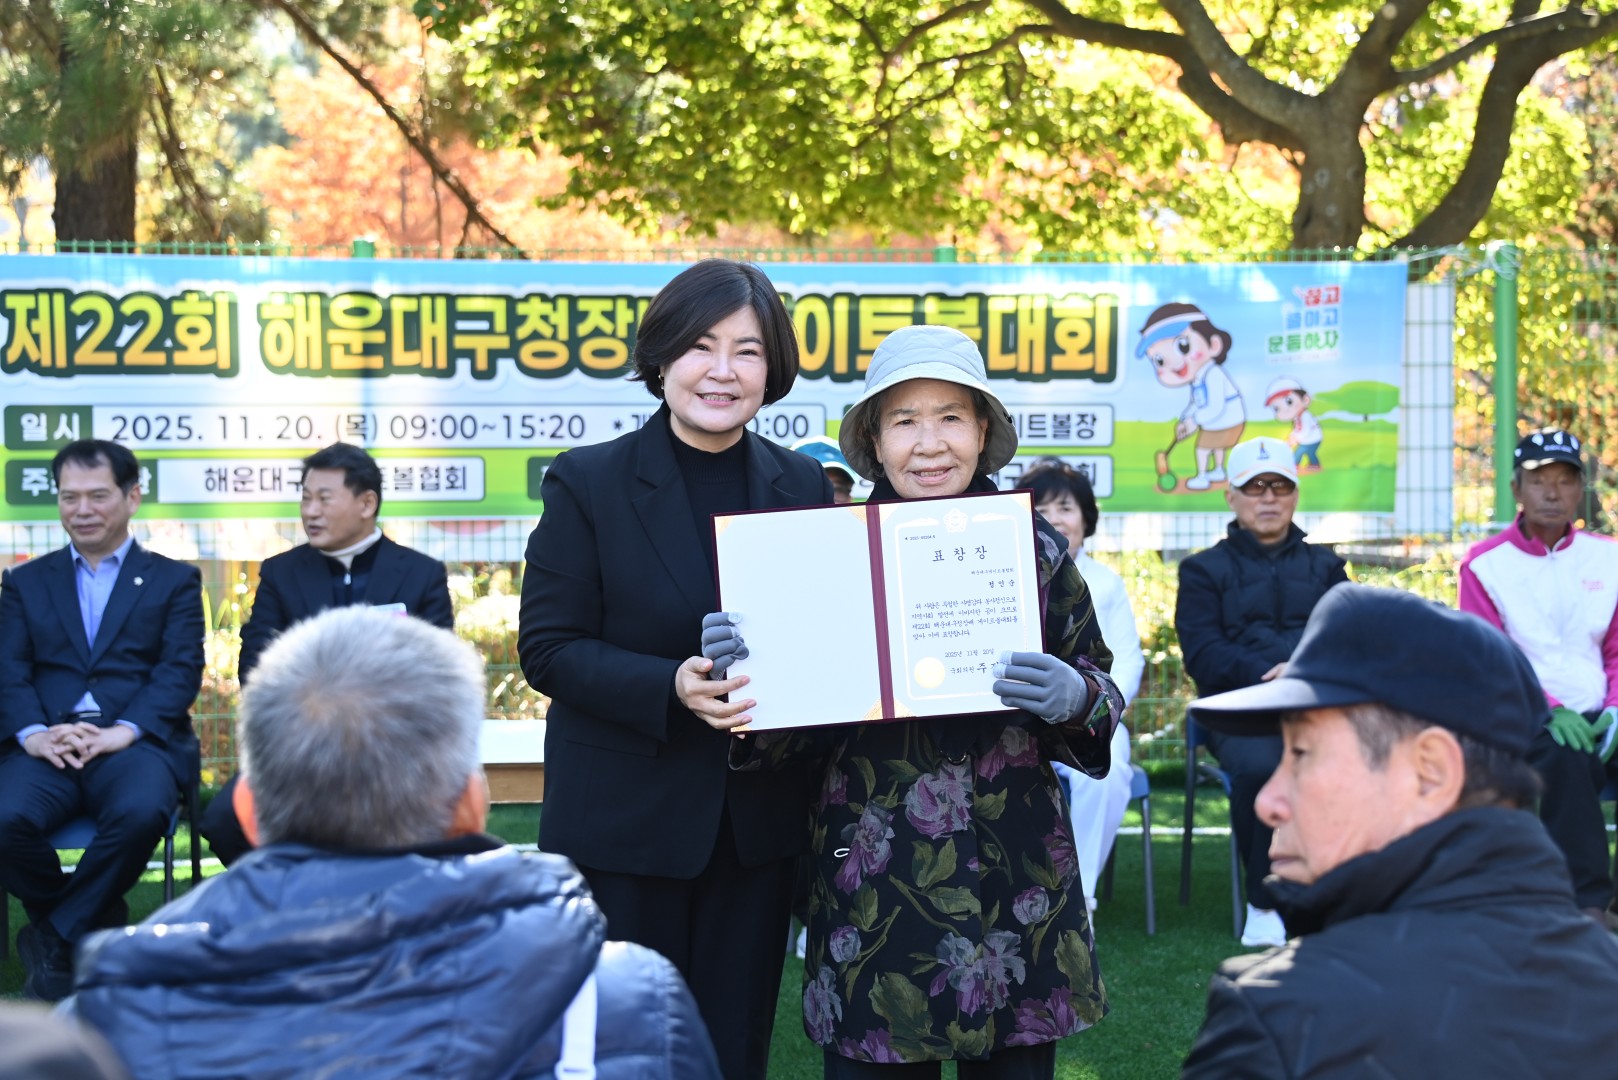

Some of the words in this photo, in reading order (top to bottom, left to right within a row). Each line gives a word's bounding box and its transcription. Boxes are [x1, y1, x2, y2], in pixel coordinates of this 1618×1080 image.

[4, 291, 231, 370] 제22회
[260, 292, 651, 372] 해운대구청장
[20, 412, 80, 441] 일시
[111, 415, 203, 440] 2025.
[218, 415, 263, 440] 11.
[276, 415, 322, 440] 20.
[336, 413, 377, 441] (목)
